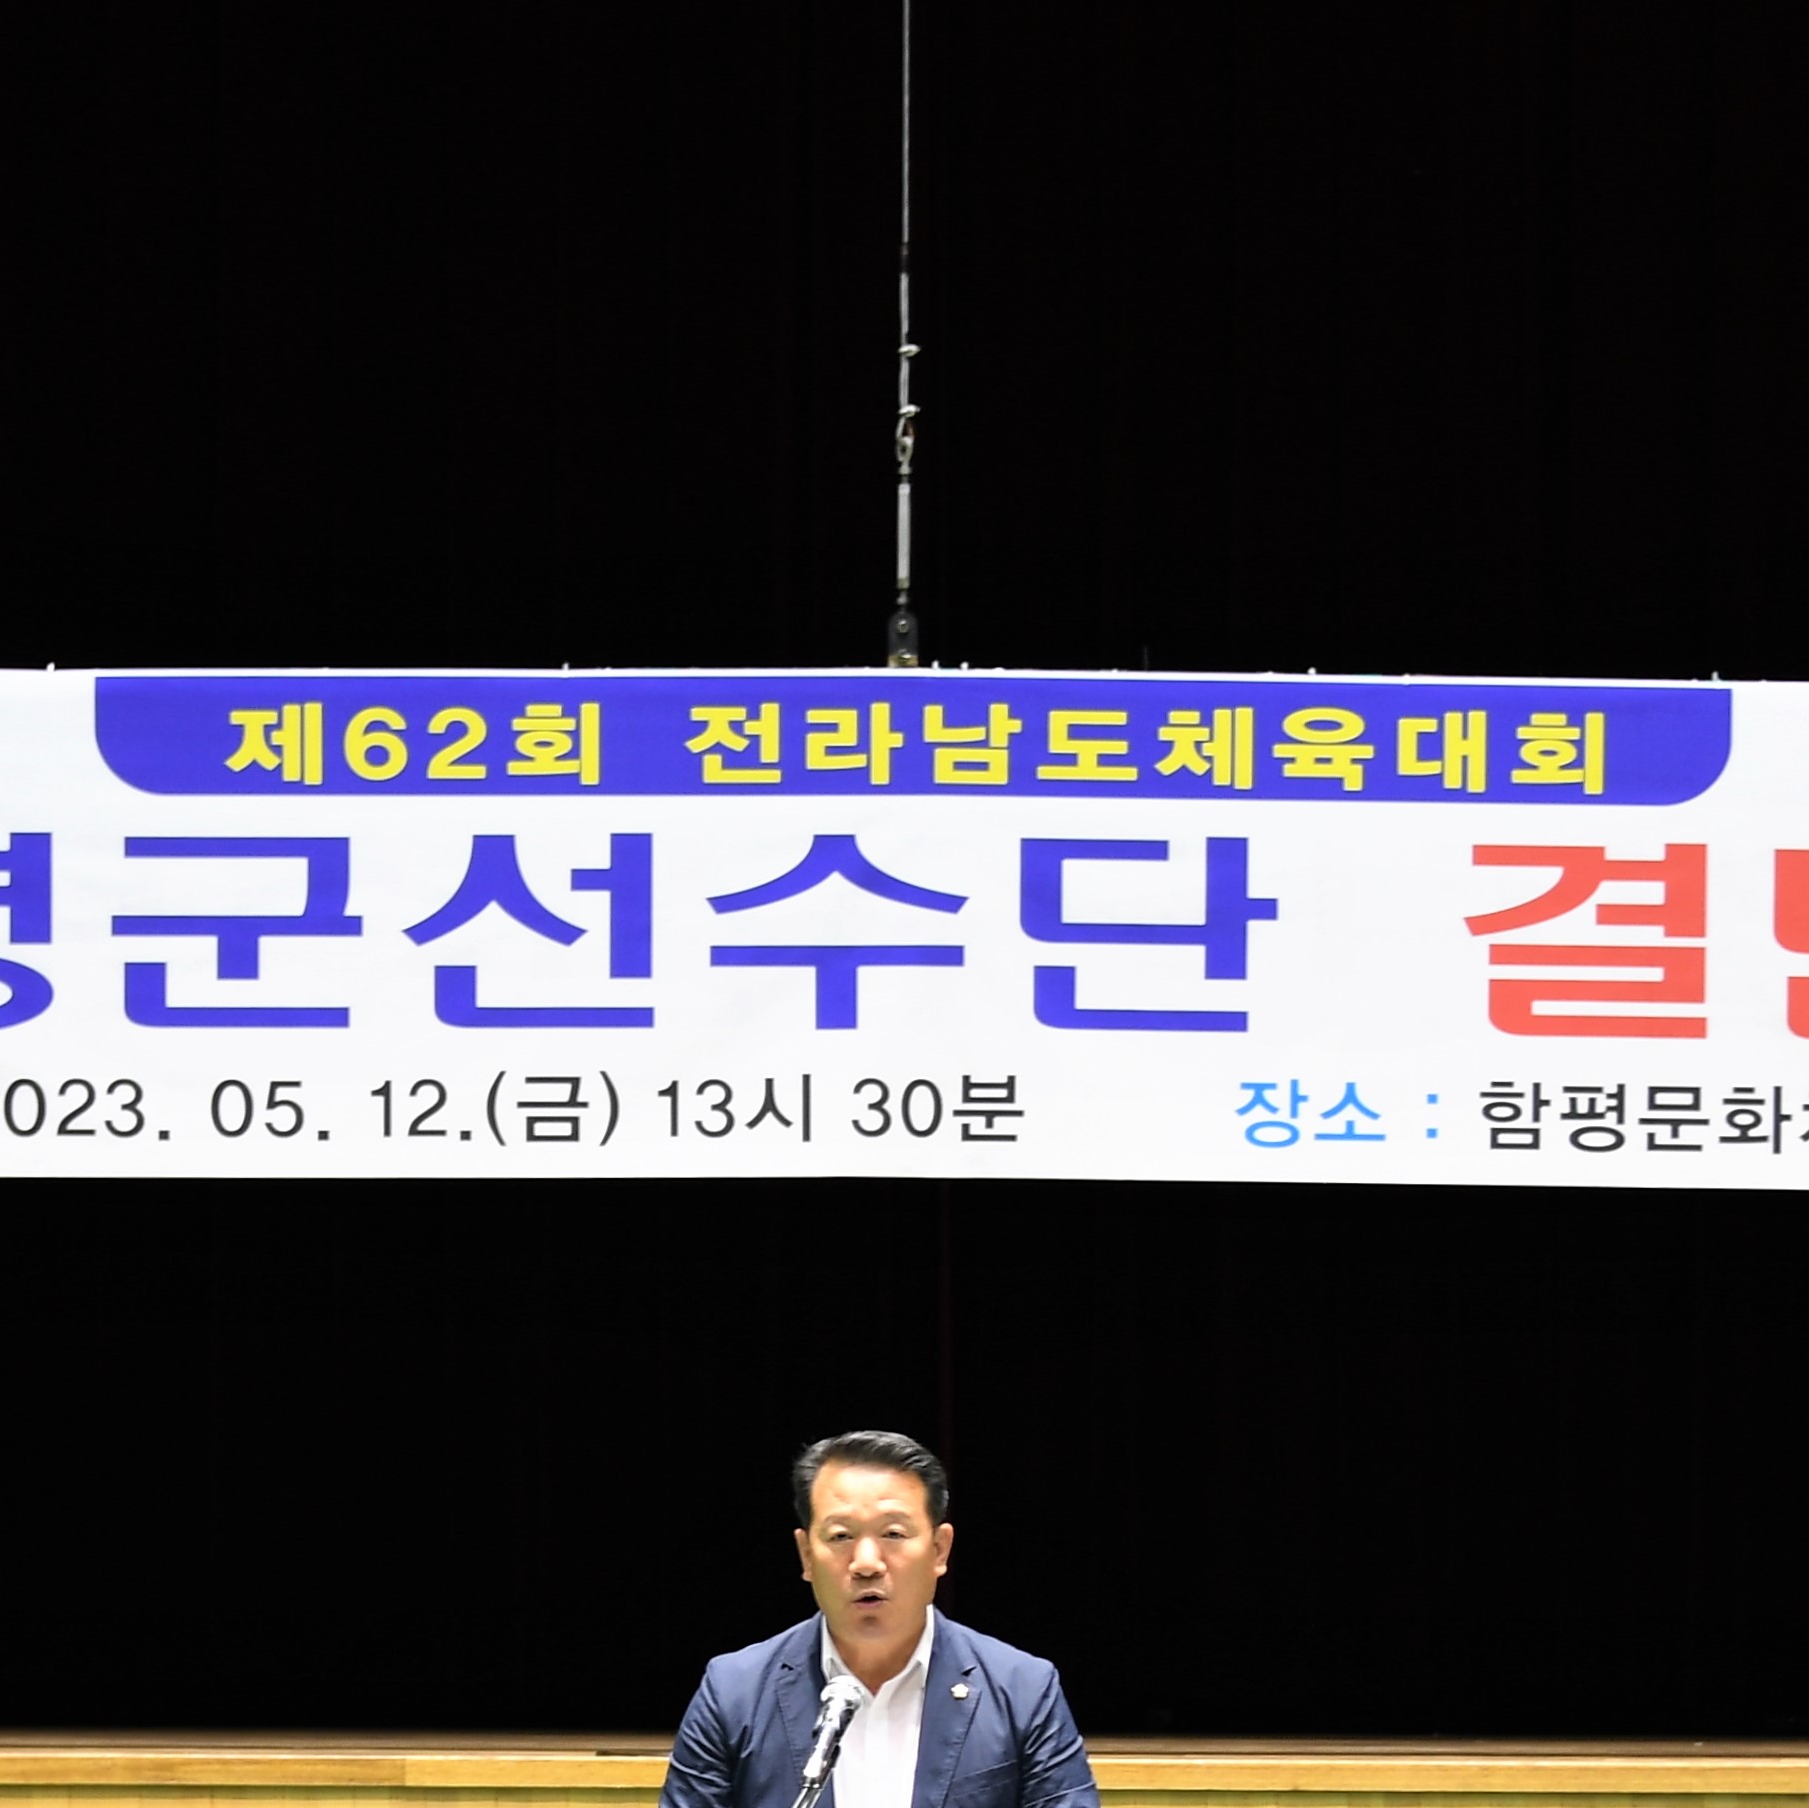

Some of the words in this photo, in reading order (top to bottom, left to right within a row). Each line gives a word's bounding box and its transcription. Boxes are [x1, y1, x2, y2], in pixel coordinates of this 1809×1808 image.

[227, 702, 600, 786] 제62회
[687, 701, 1605, 795] 전라남도체육대회
[210, 1079, 330, 1141] 05.
[370, 1070, 620, 1147] 12.(금)
[657, 1073, 811, 1143] 13시
[851, 1074, 1025, 1143] 30분
[1236, 1078, 1386, 1149] 장소
